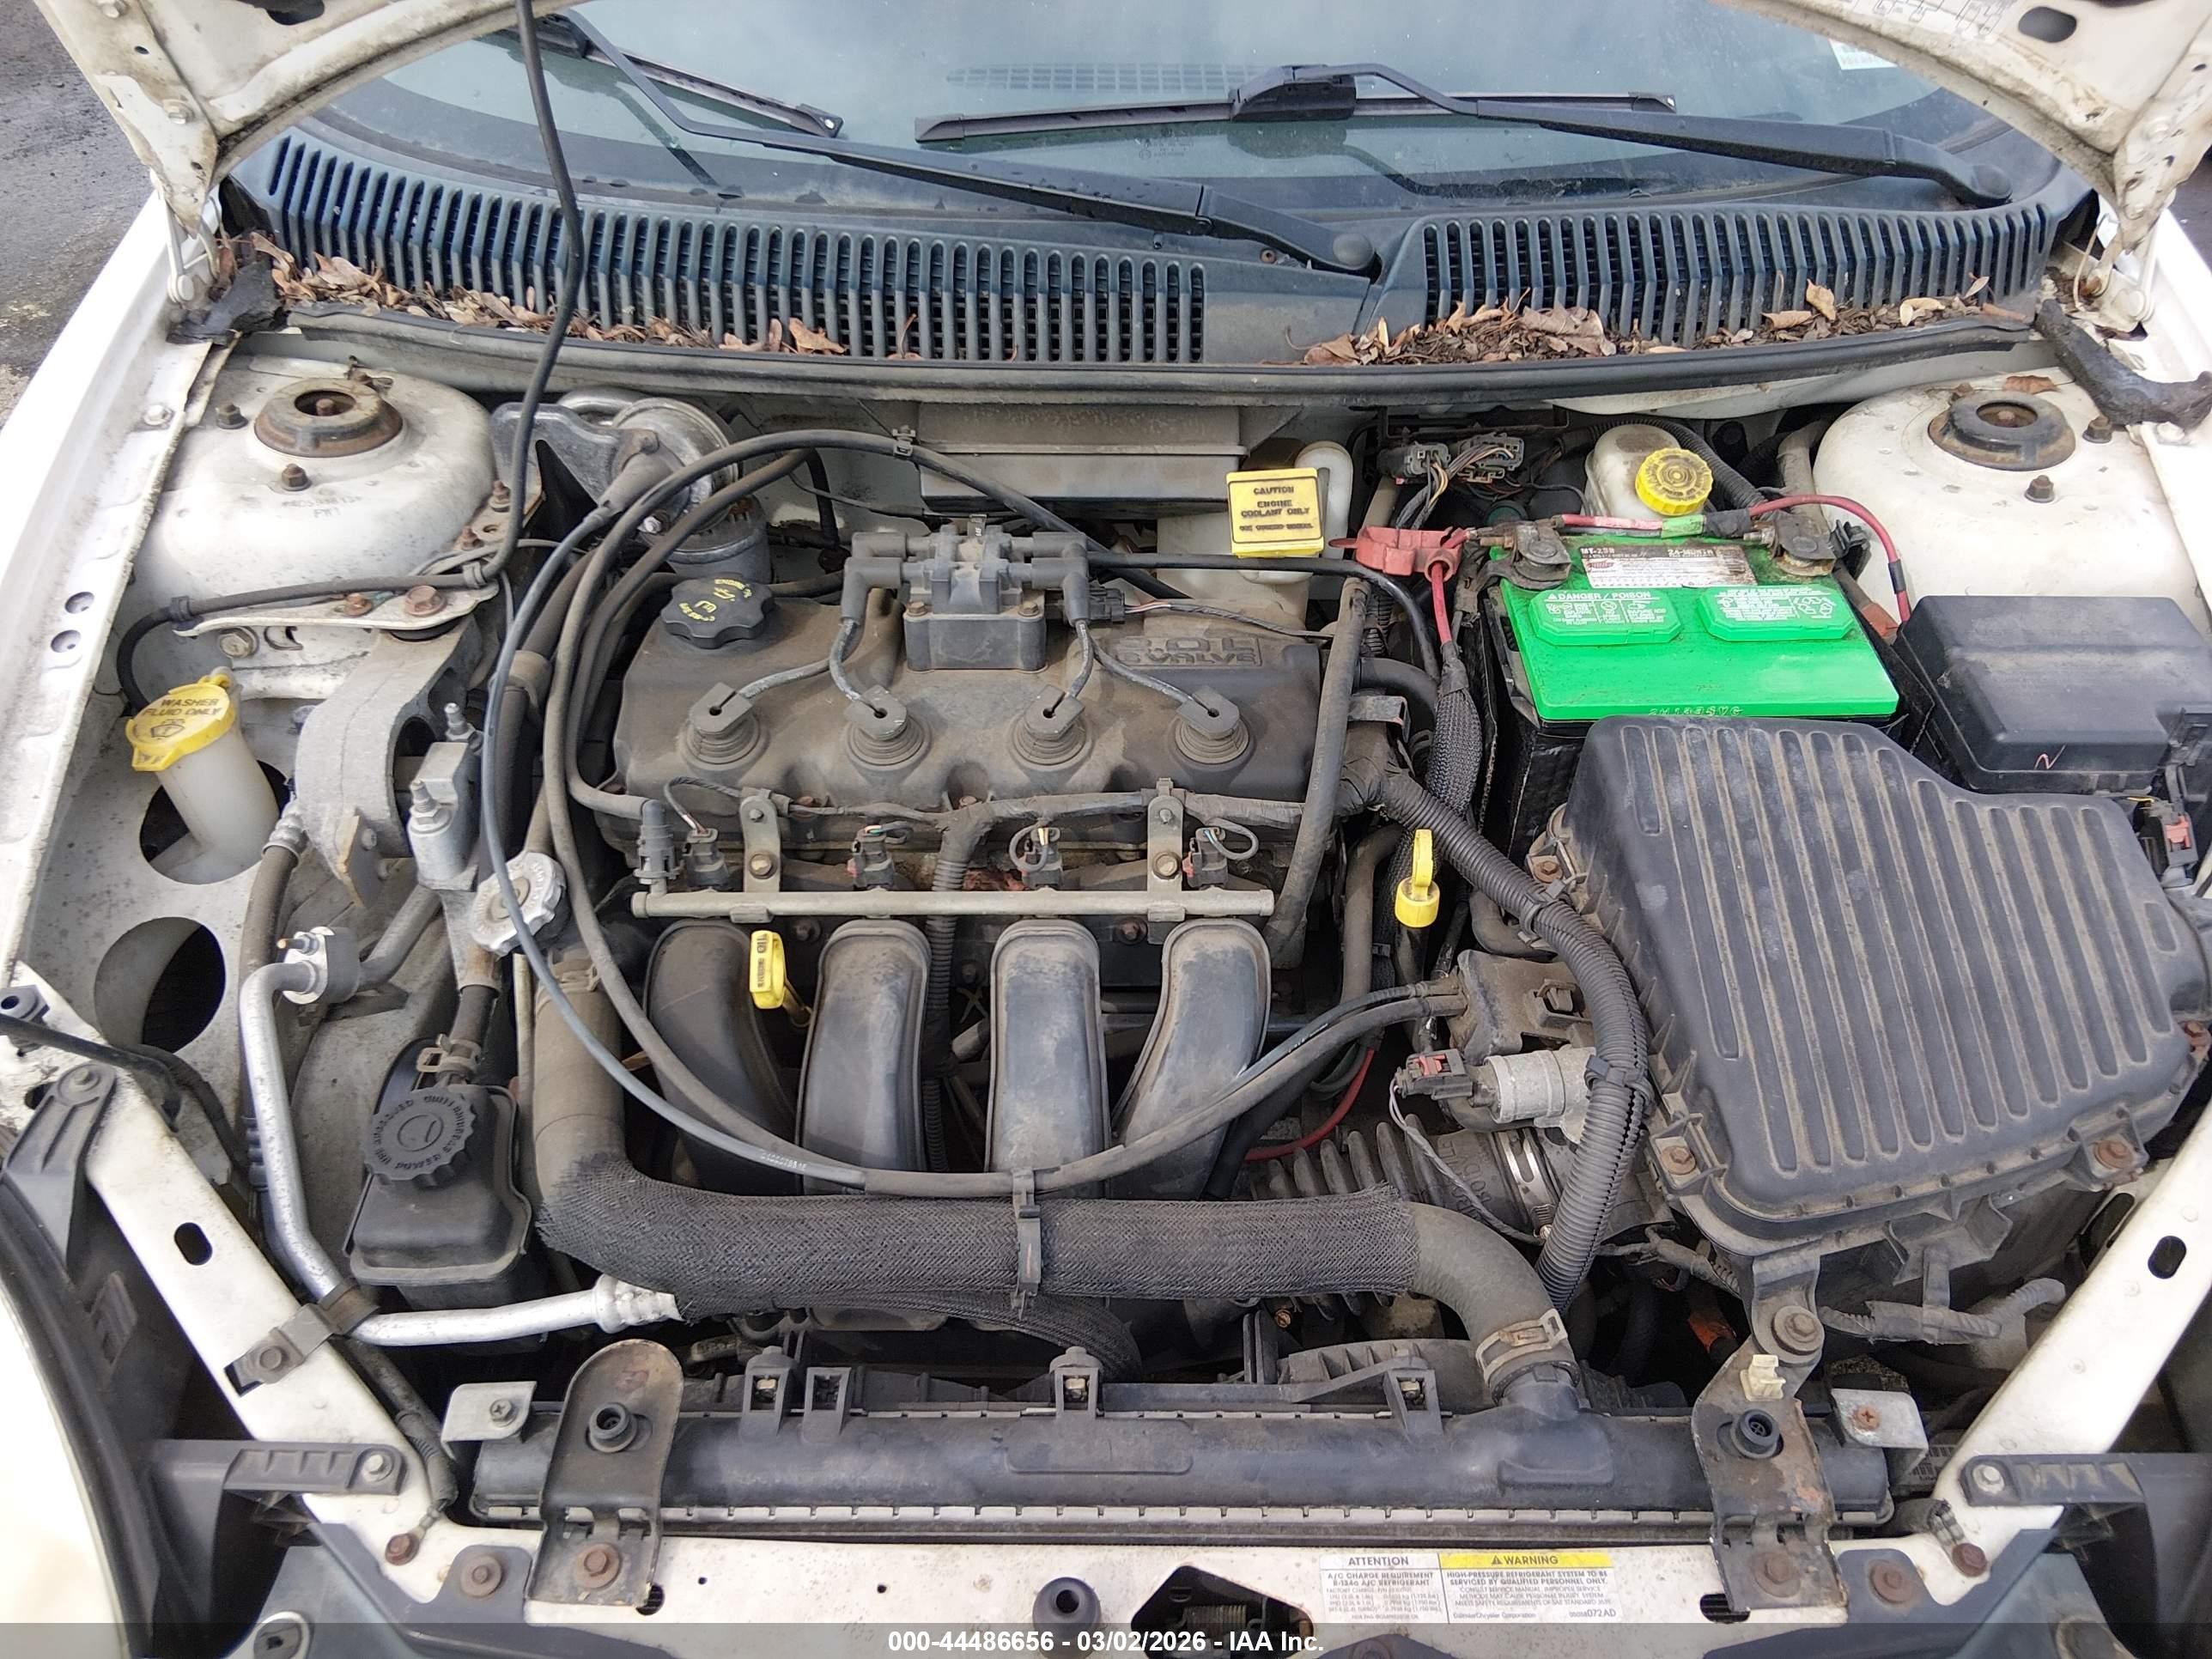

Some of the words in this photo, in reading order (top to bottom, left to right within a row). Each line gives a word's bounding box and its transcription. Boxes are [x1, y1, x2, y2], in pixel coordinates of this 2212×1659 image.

[1253, 486, 1294, 495] CAUTION
[1256, 499, 1292, 507] ENGINE
[1241, 508, 1282, 519] COOLANT
[1286, 507, 1310, 516] ONLY
[161, 698, 220, 707] WASHER
[143, 708, 182, 716] FLUID
[185, 708, 222, 716] ONLY
[757, 933, 769, 953] OIL
[1348, 1556, 1409, 1566] ATTENTION
[1504, 1555, 1559, 1565] WARNING
